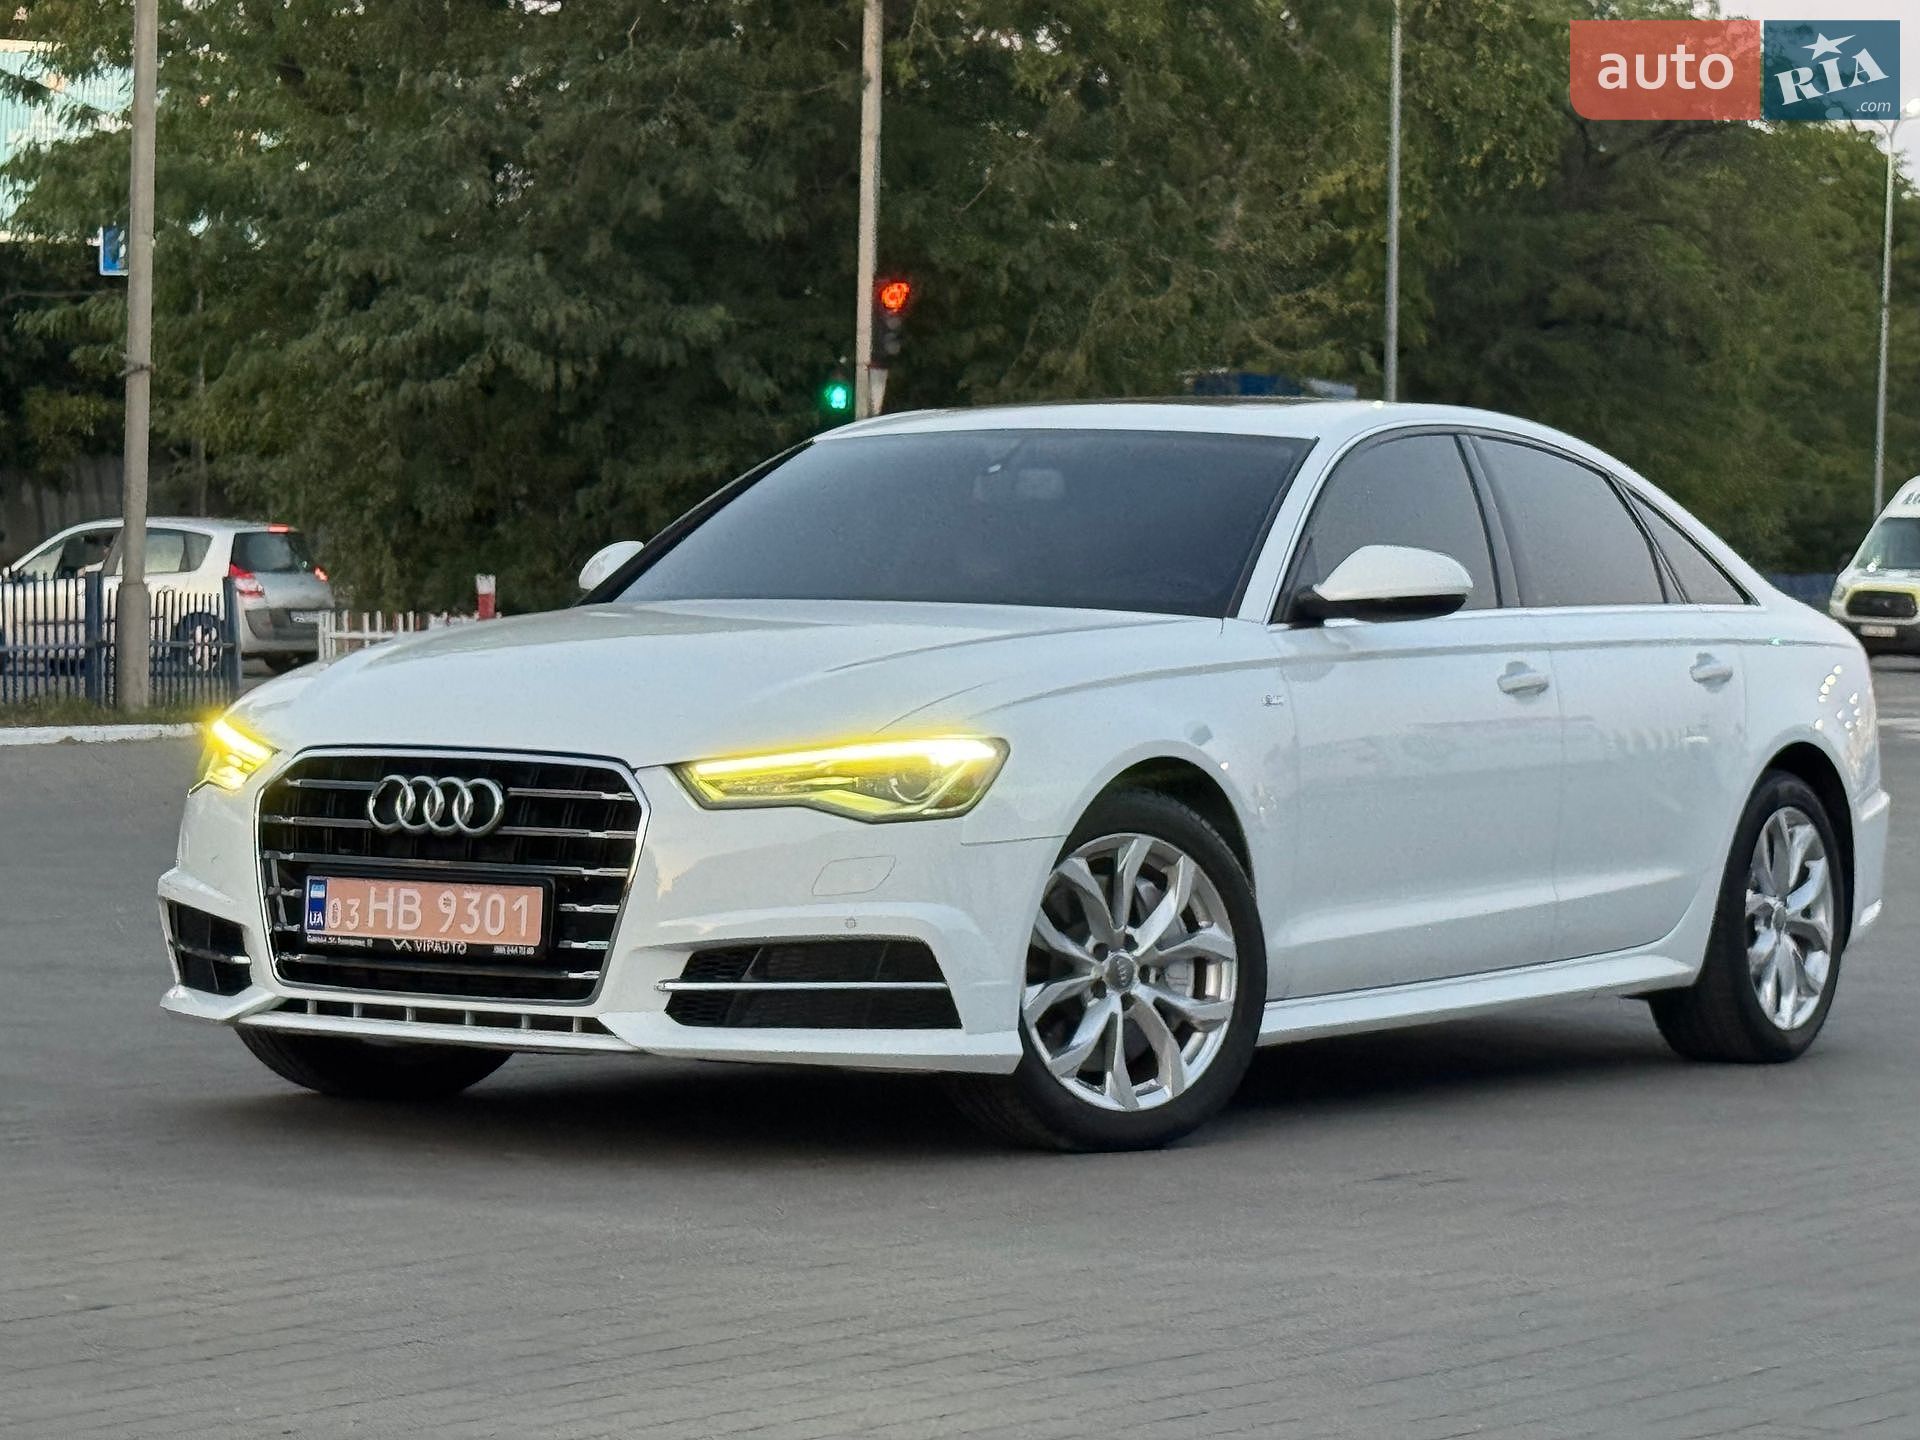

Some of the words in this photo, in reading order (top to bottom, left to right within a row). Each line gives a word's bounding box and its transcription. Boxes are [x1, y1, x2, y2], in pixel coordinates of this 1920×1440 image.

[309, 911, 324, 927] UA
[328, 897, 360, 930] 03
[367, 886, 422, 931] HB
[437, 890, 529, 937] 9301
